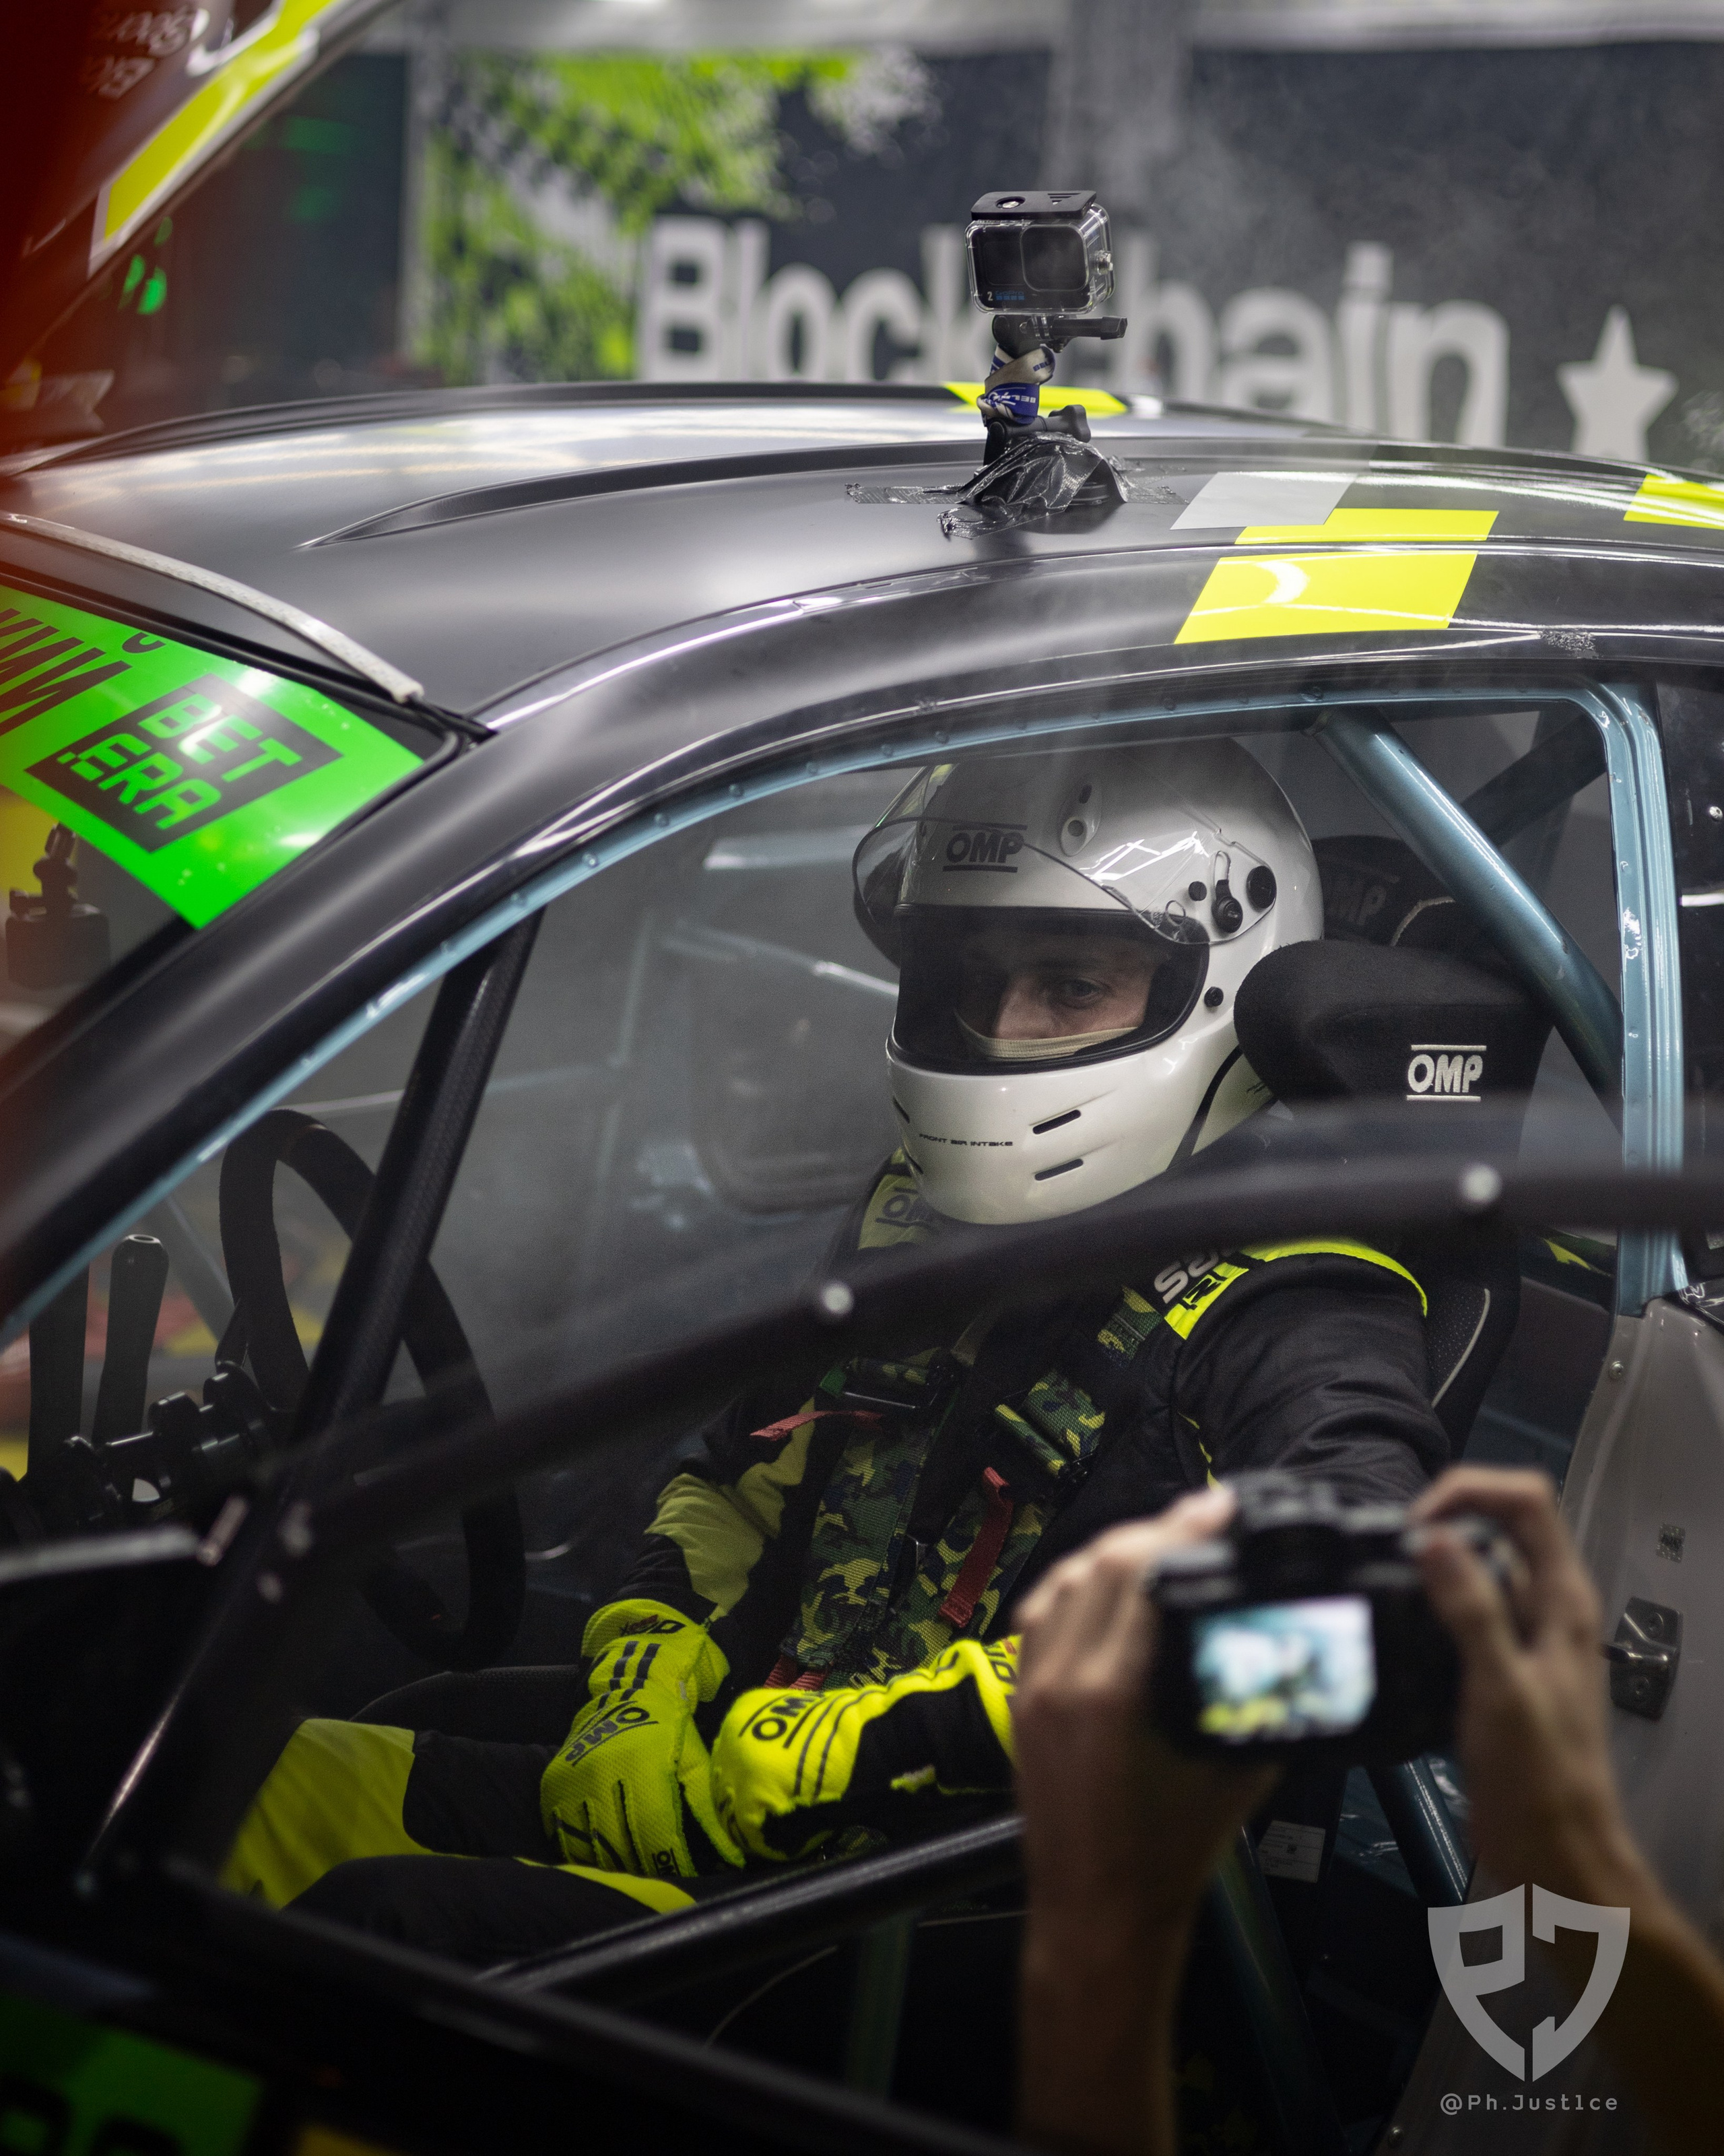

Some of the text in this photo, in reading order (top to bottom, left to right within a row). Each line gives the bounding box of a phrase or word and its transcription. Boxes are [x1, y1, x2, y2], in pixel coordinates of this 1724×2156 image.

[137, 694, 302, 783] BET
[57, 733, 222, 830] ERA
[946, 831, 1024, 863] OMP
[1407, 1054, 1483, 1092] OMP
[565, 1707, 650, 1762] OMP
